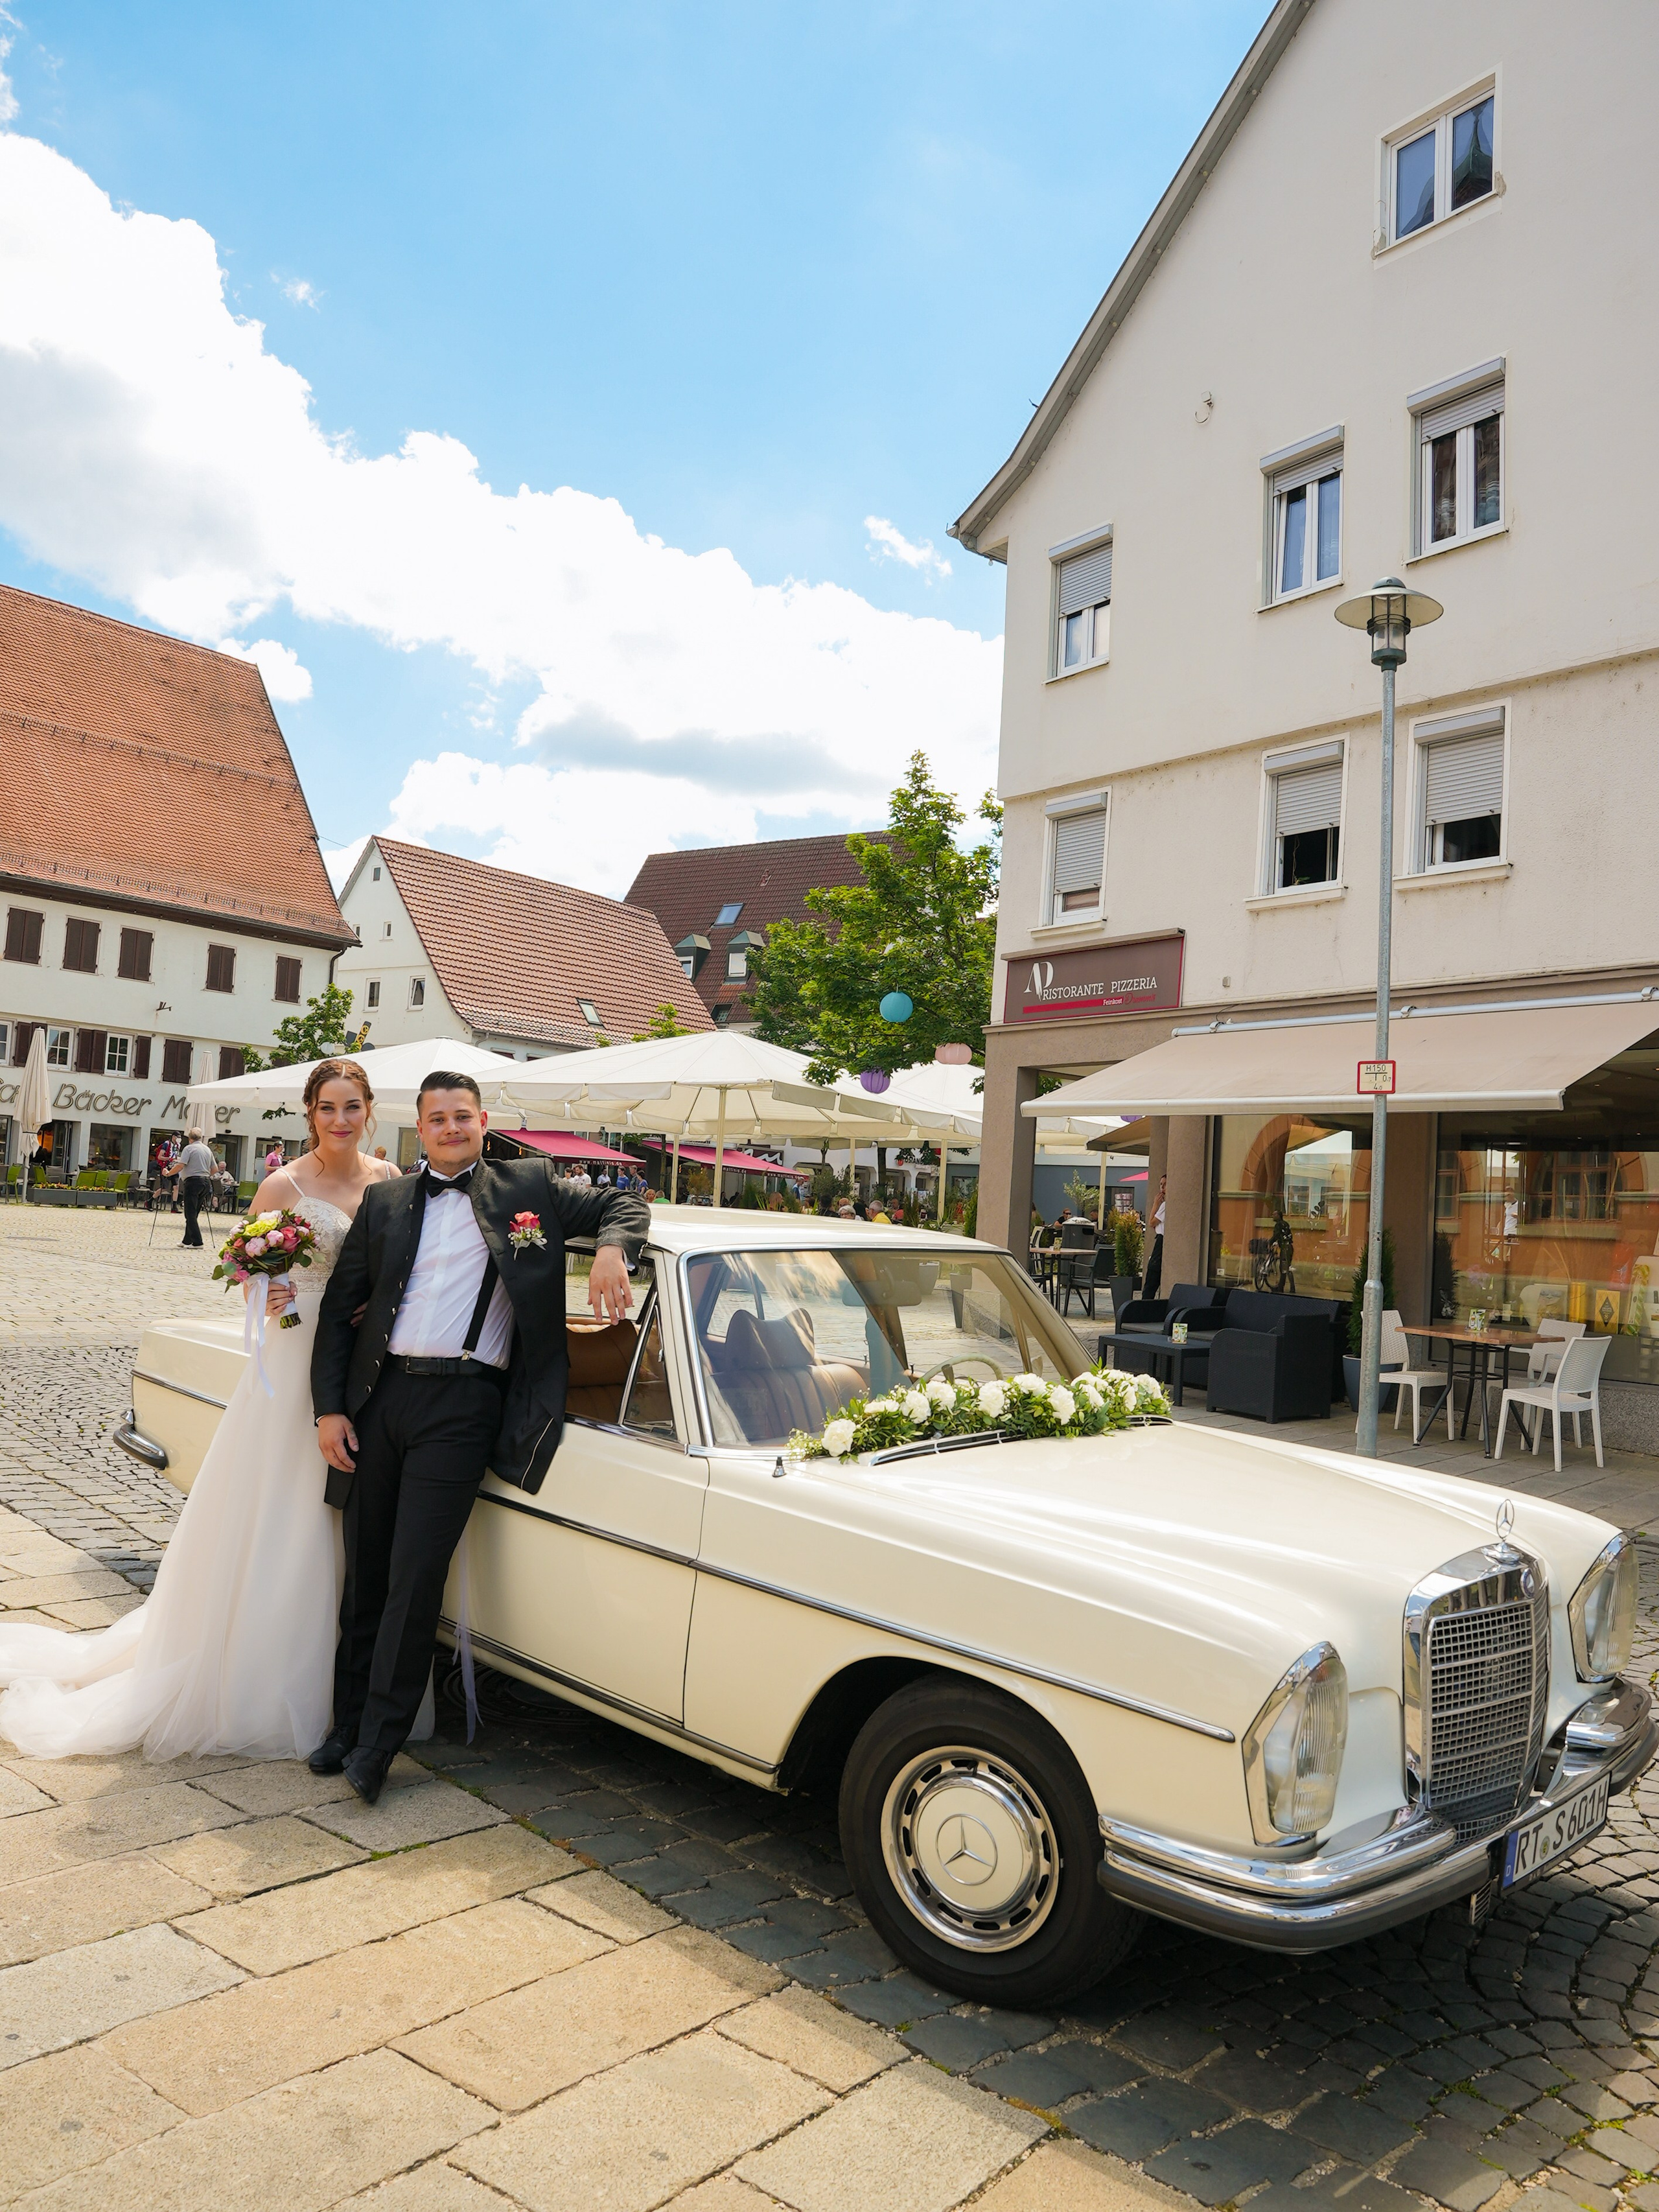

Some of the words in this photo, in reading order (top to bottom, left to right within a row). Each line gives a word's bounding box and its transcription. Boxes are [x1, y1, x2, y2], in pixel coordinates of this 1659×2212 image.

[1043, 983, 1104, 1001] RISTORANTE
[1110, 977, 1157, 994] PIZZERIA
[53, 1083, 152, 1116] Bäcker
[161, 1095, 240, 1124] Mer
[1515, 1822, 1543, 1875] RT
